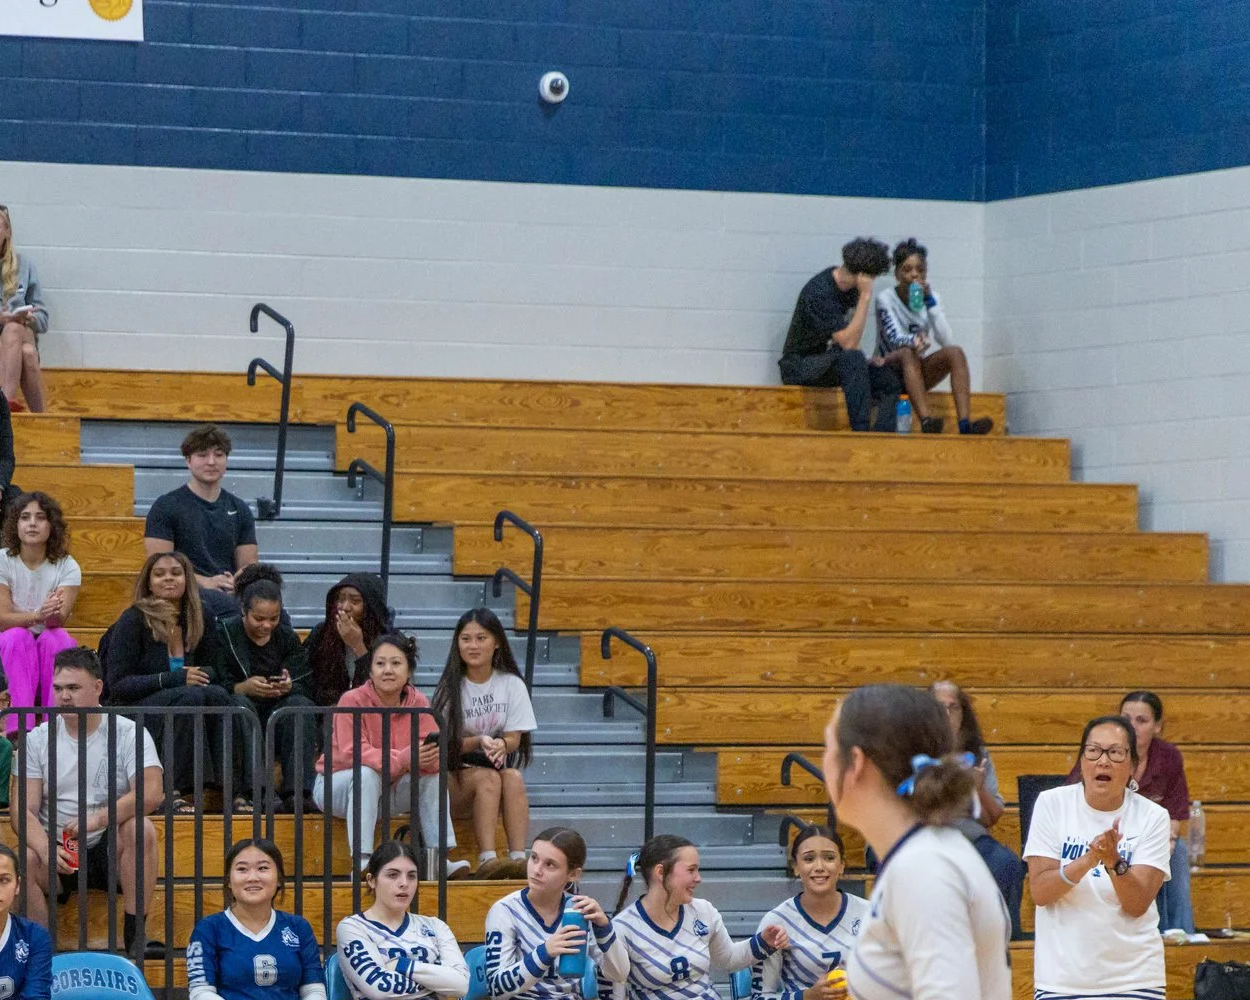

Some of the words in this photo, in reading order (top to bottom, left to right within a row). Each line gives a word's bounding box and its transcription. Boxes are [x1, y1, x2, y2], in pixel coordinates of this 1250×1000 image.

[253, 954, 278, 987] 6
[670, 956, 690, 982] 8
[822, 951, 841, 972] 7
[51, 968, 139, 995] CORSAIRS
